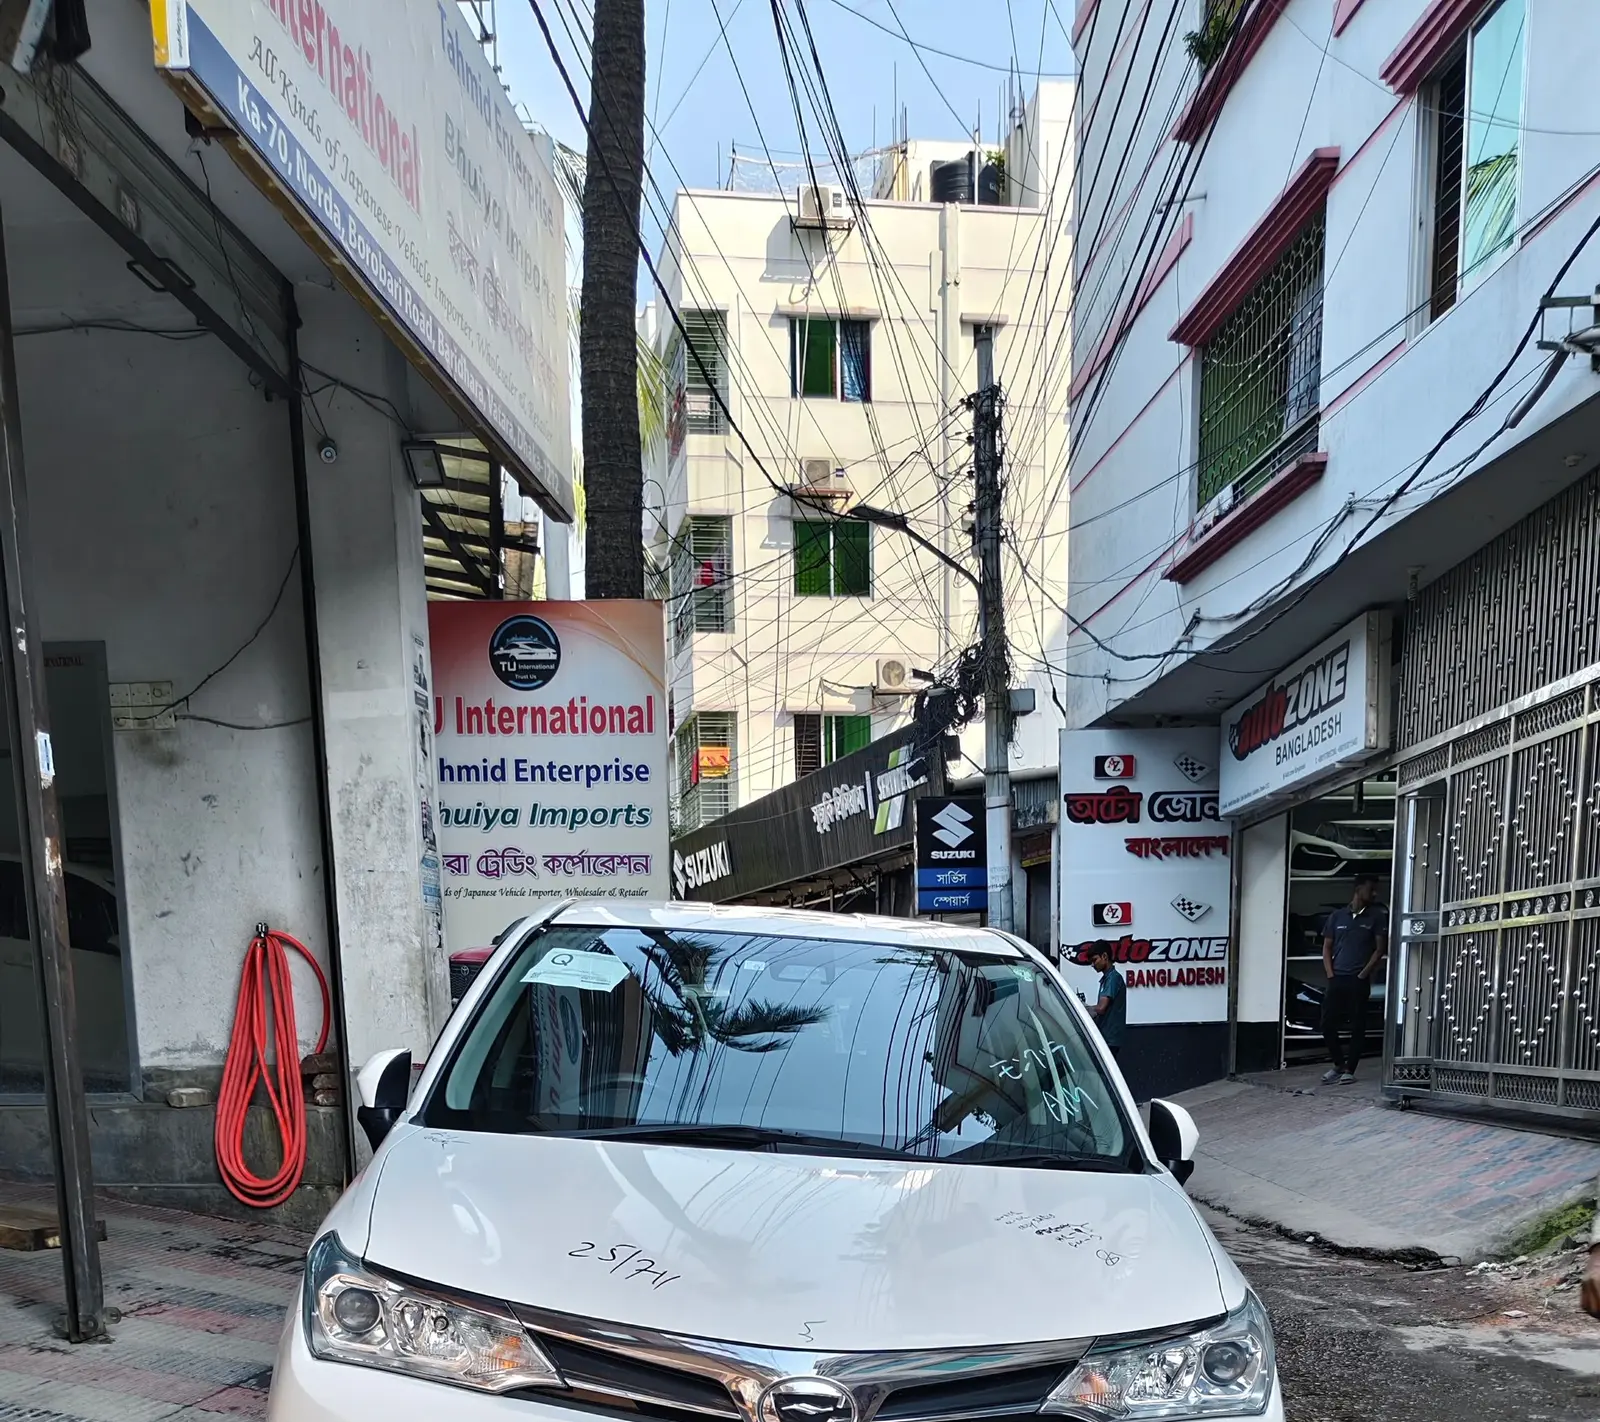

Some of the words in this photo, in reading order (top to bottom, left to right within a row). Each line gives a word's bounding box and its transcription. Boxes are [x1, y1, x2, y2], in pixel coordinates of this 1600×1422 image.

[436, 0, 493, 132] Tahmid
[494, 101, 555, 236] Enterprise
[248, 36, 279, 84] All
[279, 69, 323, 144] Kinds
[325, 137, 341, 171] of
[341, 152, 393, 238] Japanese
[395, 223, 432, 288] Vehicle
[444, 112, 501, 234] Bhuiya
[237, 75, 294, 176] Ka-70,
[296, 148, 346, 243] Norda,
[348, 212, 403, 308] Borobari
[404, 287, 436, 350] Road,
[437, 325, 487, 411] Baridhara,
[499, 661, 517, 672] TU
[518, 663, 556, 671] International
[455, 695, 655, 735] International
[1275, 712, 1343, 768] BANGLADESH
[439, 757, 507, 783] hmid
[514, 757, 651, 788] Enterprise
[438, 801, 520, 831] huiya
[529, 802, 652, 831] Imports
[1065, 785, 1143, 824] অটো
[442, 853, 469, 876] রা
[542, 849, 652, 876] কর্পোরেশন
[930, 850, 976, 860] SUZUKI
[1124, 836, 1230, 861] বাংলাদেশ
[684, 840, 733, 890] SUZUKI
[936, 869, 968, 885] সার্ভিস
[444, 887, 453, 898] ds
[453, 887, 465, 899] of
[462, 887, 497, 899] Japanese
[498, 886, 526, 897] Vehicle
[528, 888, 563, 899] Importer,
[564, 886, 607, 897] Wholesaler
[607, 887, 618, 898] &
[618, 887, 649, 898] Retailer
[933, 891, 971, 908] স্পেয়ার্স
[551, 953, 574, 967] Q
[1076, 934, 1229, 963] atoZONE
[1125, 966, 1226, 988] BANGLADESH
